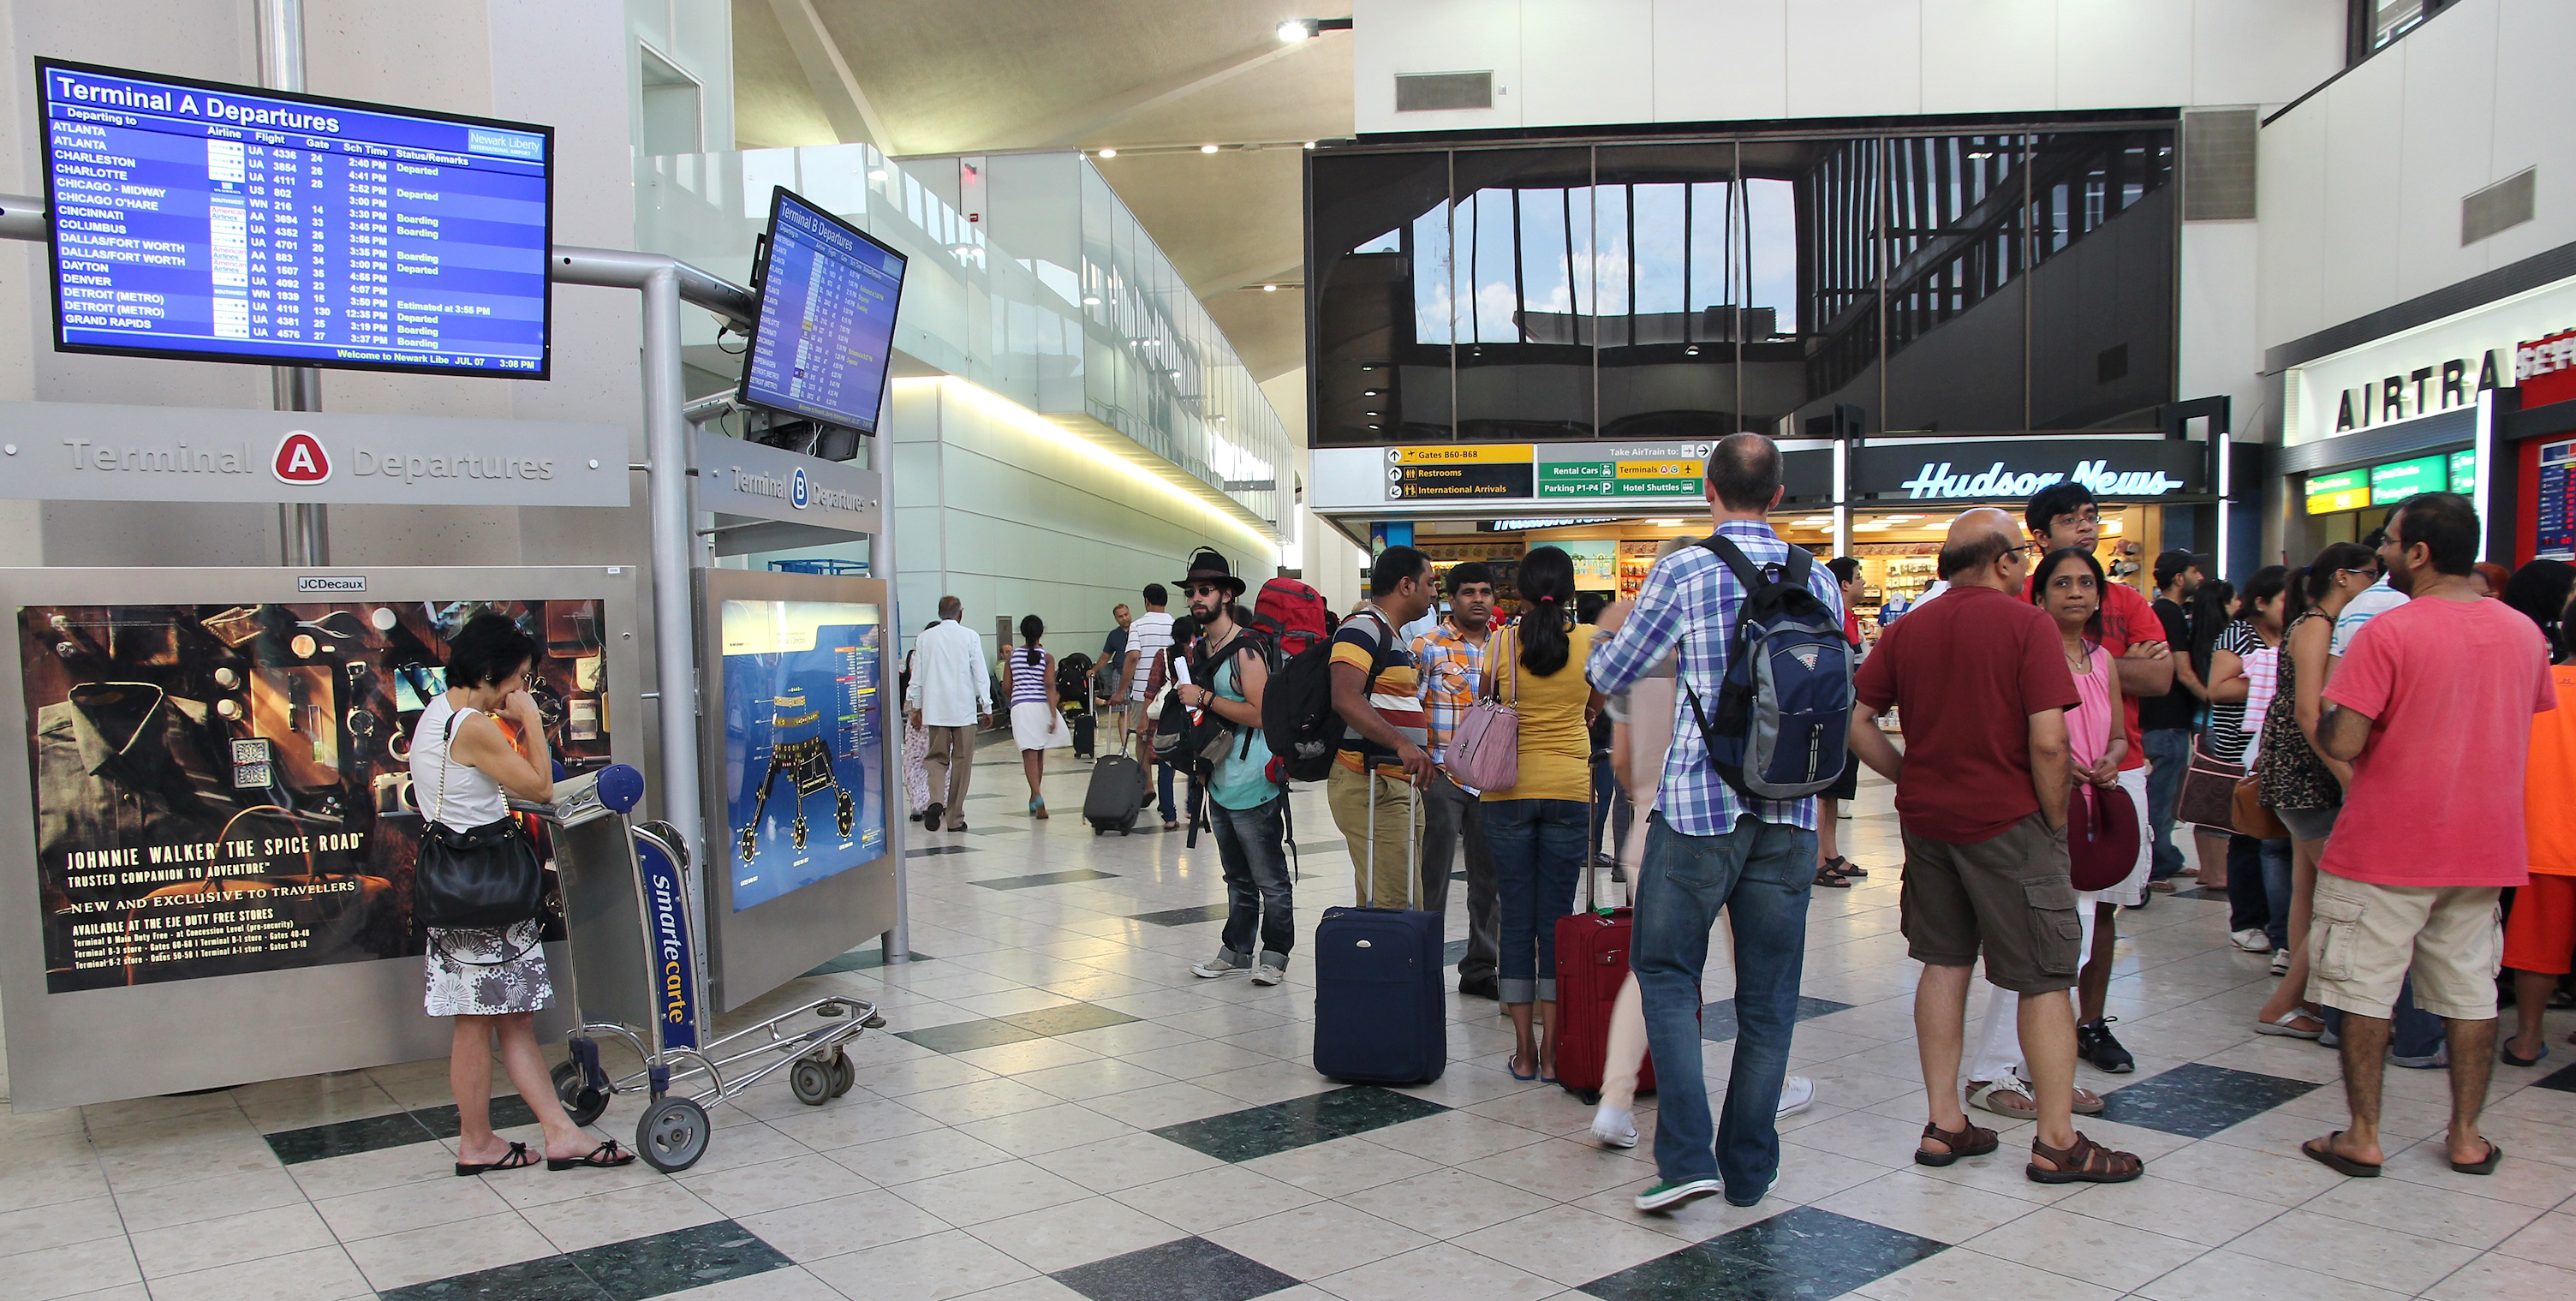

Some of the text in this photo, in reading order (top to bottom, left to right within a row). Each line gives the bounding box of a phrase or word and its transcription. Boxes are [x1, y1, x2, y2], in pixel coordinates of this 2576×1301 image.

[57, 76, 339, 132] Terminal A Departures
[67, 107, 137, 125] Departing to
[53, 121, 106, 137] ATLANTA
[207, 126, 242, 138] Airline
[54, 135, 107, 151] ATLANTA
[255, 132, 285, 144] Flight
[306, 138, 329, 149] Gate
[471, 132, 540, 153] Newark Liberty
[343, 143, 388, 156] Sch Time
[396, 149, 468, 165] Status/Remarks
[55, 149, 135, 167] CHARLESTON
[55, 164, 127, 180] CHARLOTTE
[396, 163, 438, 175] Departed
[57, 178, 111, 192] CHICAGO
[121, 184, 166, 198] MIDWAY
[397, 188, 438, 201] Departed
[57, 192, 158, 211] CHICAGO O'HARE
[58, 205, 124, 220] CINCINNATI
[397, 213, 438, 227] Boarding
[59, 219, 126, 234] COLUMBUS
[397, 226, 438, 240] Boarding
[782, 202, 853, 251] Terminal B Departures
[60, 233, 185, 253] DALLAS/FORT WORTH
[397, 251, 438, 264] Boarding
[62, 260, 108, 273] DAYTON
[397, 263, 438, 275] Departed
[63, 273, 112, 286] DENVER
[64, 287, 164, 305] DETROIT (METRO)
[397, 300, 442, 312] Estimated
[455, 305, 474, 314] 3:55
[476, 307, 490, 315] PM
[65, 314, 151, 329] GRAND RAPIDS
[397, 313, 438, 323] Departed
[397, 325, 438, 337] Boarding
[337, 349, 380, 360] Welcome
[394, 353, 428, 362] Newark
[430, 355, 449, 364] Libe
[454, 357, 485, 366] JUL 07
[500, 359, 534, 369] 3:08 PM
[1610, 448, 1629, 457] Take
[63, 438, 554, 485] Terminal A Departures
[2071, 460, 2183, 495] News
[731, 465, 865, 512] Terminal B Departures
[1418, 485, 1507, 494] International Arrivals
[1544, 484, 1574, 493] Parking
[1577, 483, 1599, 492] P1-P4
[1623, 483, 1680, 492] Hotel Shuttles
[301, 579, 363, 589] JCDecaux
[68, 848, 139, 870] JOHNNIE
[226, 840, 255, 858] THE
[265, 836, 310, 855] SPICE
[68, 874, 115, 888] TRUSTED
[122, 869, 183, 884] COMPANION
[189, 867, 202, 878] TO
[71, 881, 355, 914] NEW AND EXCLUSIVE TO TRAVELLERS
[73, 908, 273, 936] AVAILABLE AT THE EJE DUTY FREE STORES
[73, 937, 104, 947] Terminal
[115, 935, 132, 943] Main
[134, 934, 150, 942] Duty
[186, 927, 224, 937] Concession
[226, 924, 244, 933] Level
[246, 920, 293, 932] (pre-security)
[74, 948, 105, 958] Terminal
[108, 947, 120, 955] B-3
[200, 937, 230, 946] Terminal
[653, 874, 686, 1023] smartecarte
[75, 959, 106, 969] Terminal
[109, 958, 121, 966] B-2
[124, 956, 142, 965] store
[151, 952, 171, 962] Gates
[201, 947, 230, 957] Terminal
